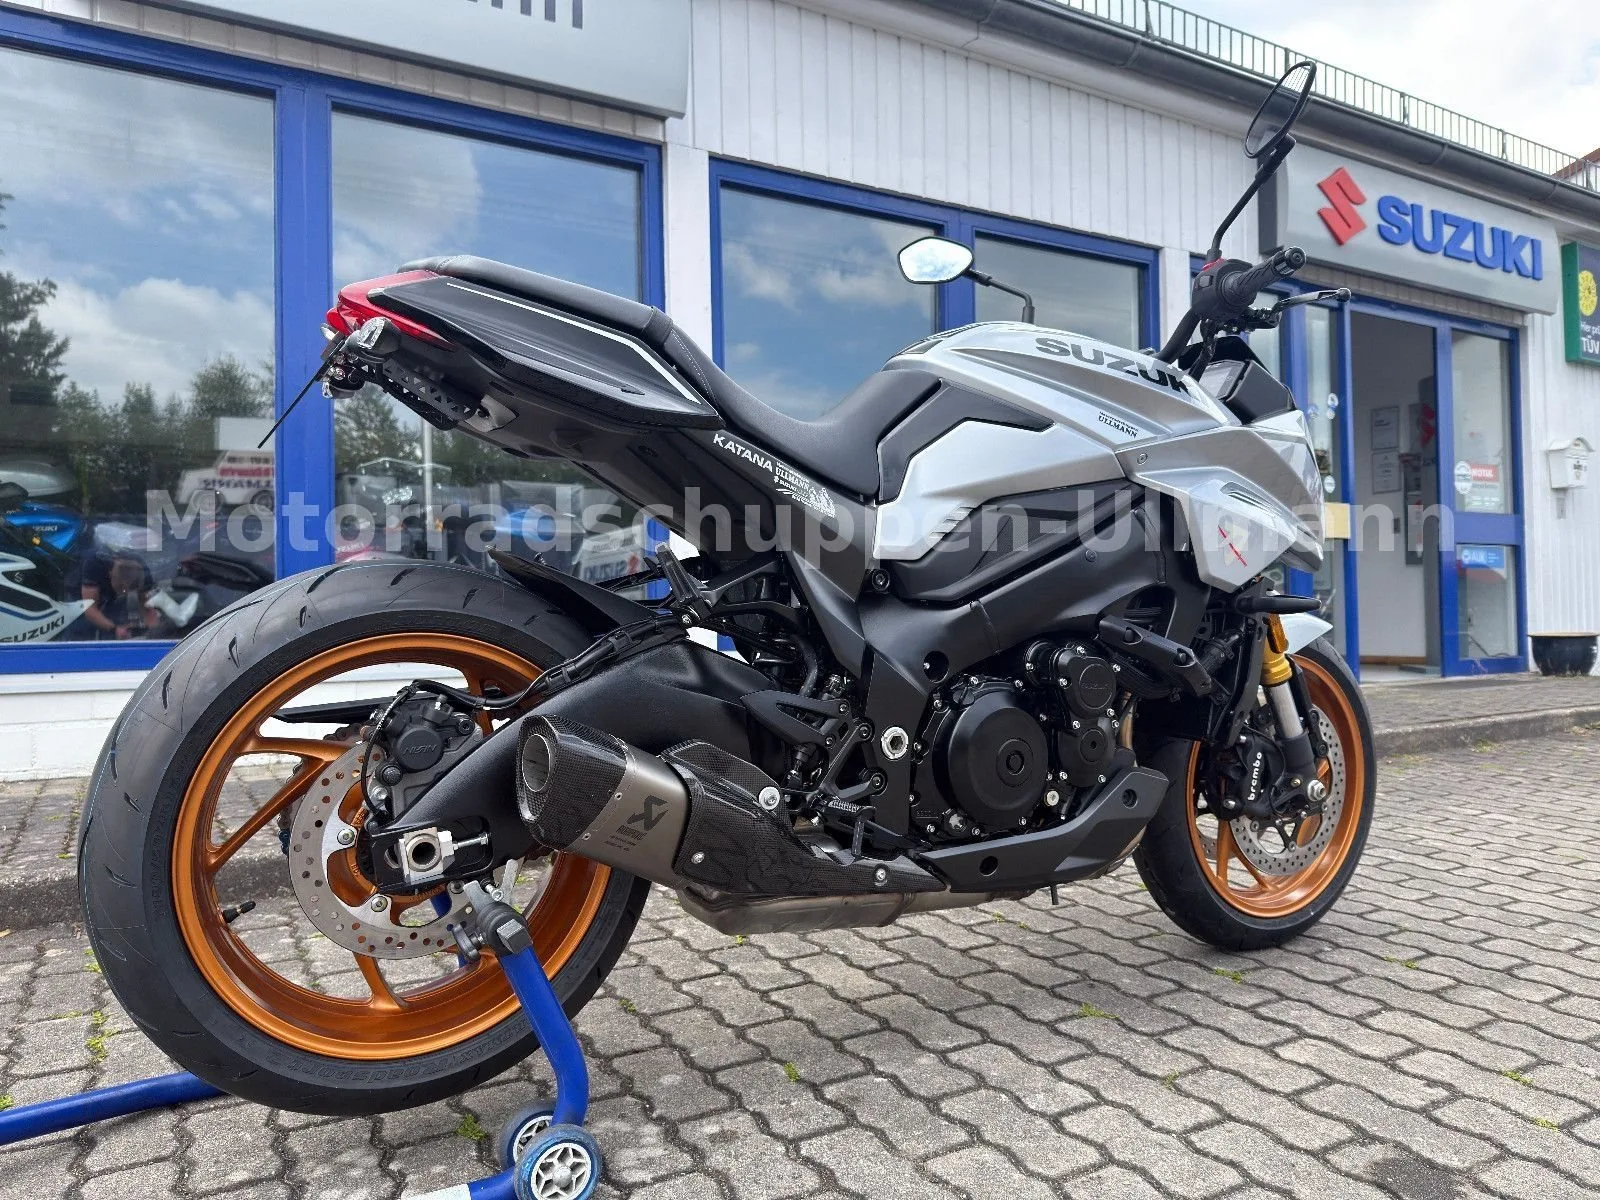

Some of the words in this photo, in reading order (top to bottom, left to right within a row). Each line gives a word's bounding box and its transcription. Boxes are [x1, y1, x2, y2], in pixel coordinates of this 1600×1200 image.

[1378, 195, 1543, 281] SUZUKI
[1581, 335, 1600, 355] TÜV
[1098, 415, 1138, 439] ULLMANN
[713, 433, 773, 473] KATANA
[775, 466, 810, 492] ULLMANN
[1248, 752, 1263, 800] brembo
